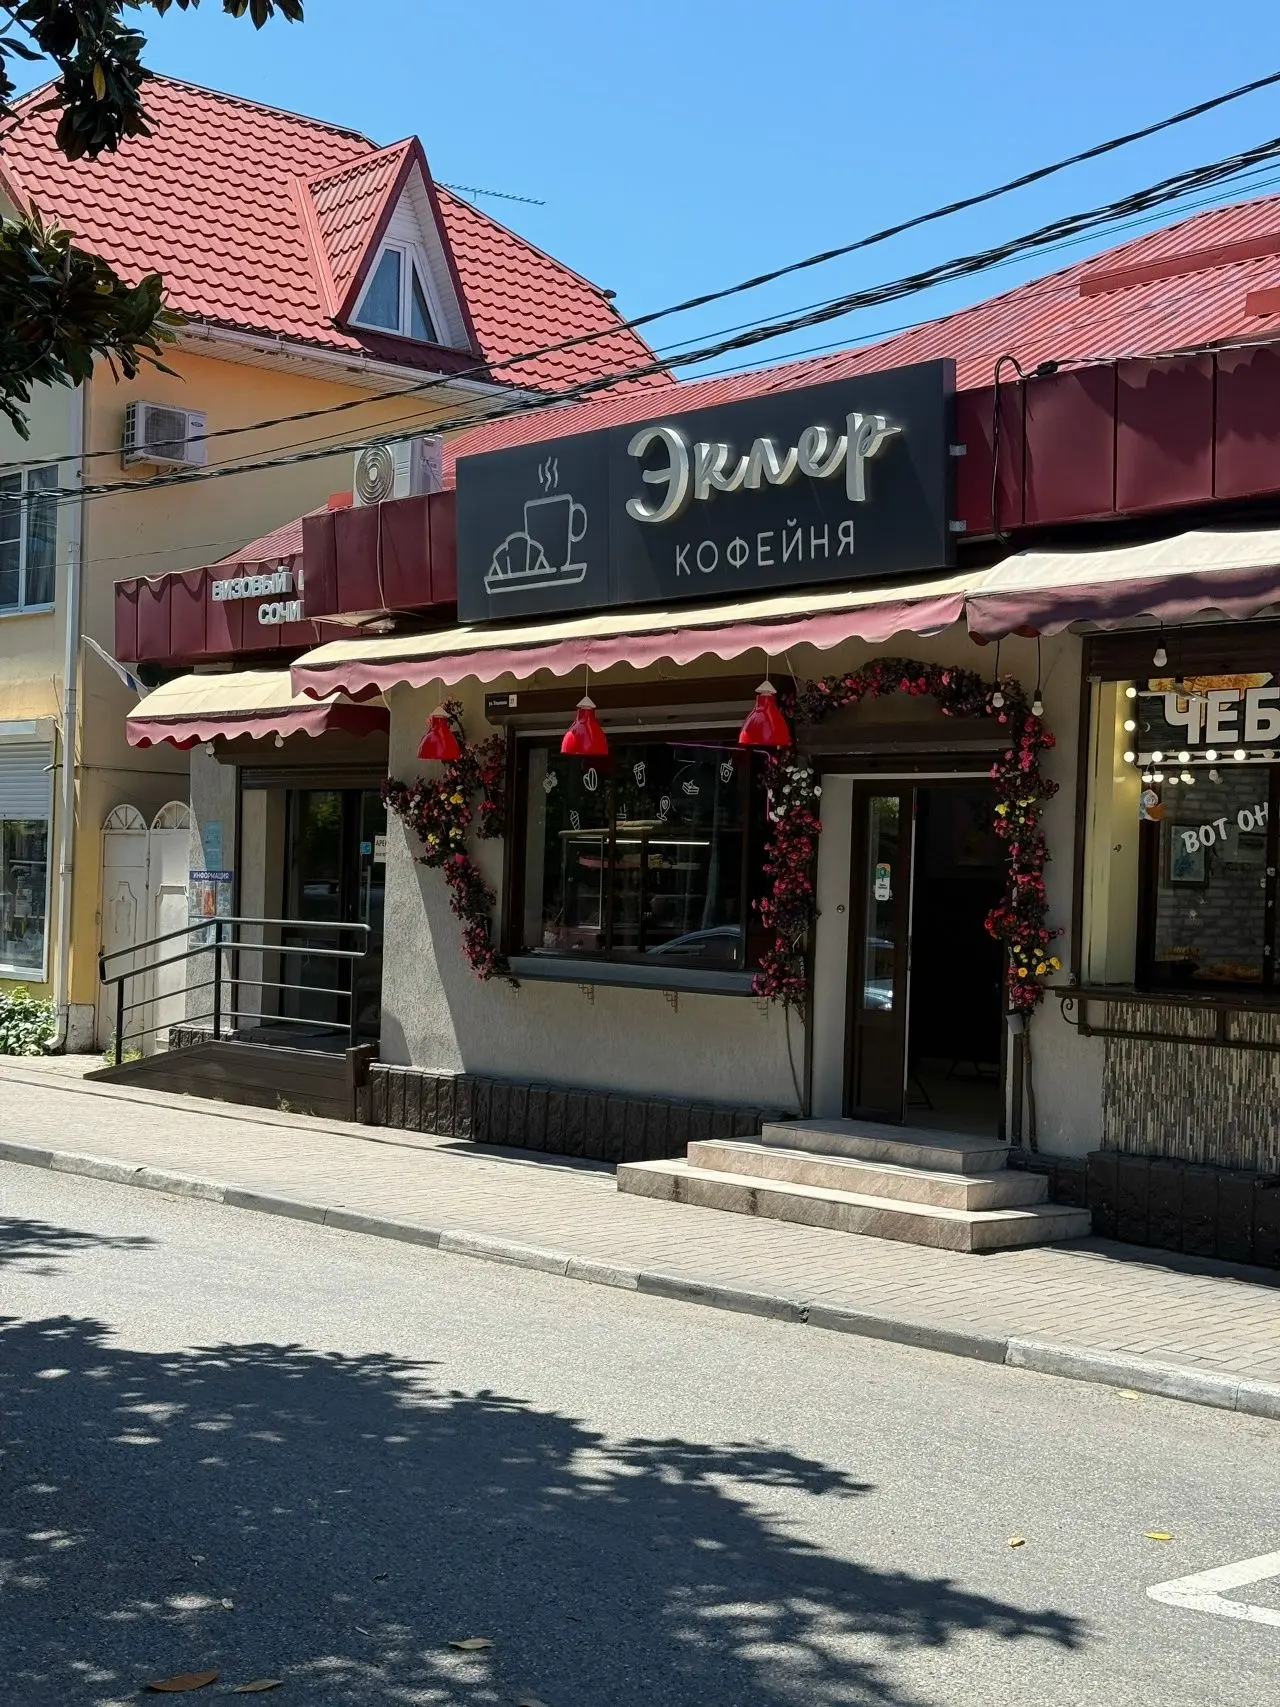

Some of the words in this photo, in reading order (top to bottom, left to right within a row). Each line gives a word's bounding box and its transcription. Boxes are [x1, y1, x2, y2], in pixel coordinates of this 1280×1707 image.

[626, 412, 901, 522] Эклер
[676, 518, 854, 577] КОФЕЙНЯ
[212, 566, 292, 600] ВИЗОВЫЙ
[258, 600, 304, 625] СОЧИ
[1165, 687, 1280, 745] ЧЕБ
[1181, 817, 1228, 853] ВОТ
[1237, 802, 1268, 832] ОН
[192, 871, 230, 881] ИНФОРМАЦИЯ
